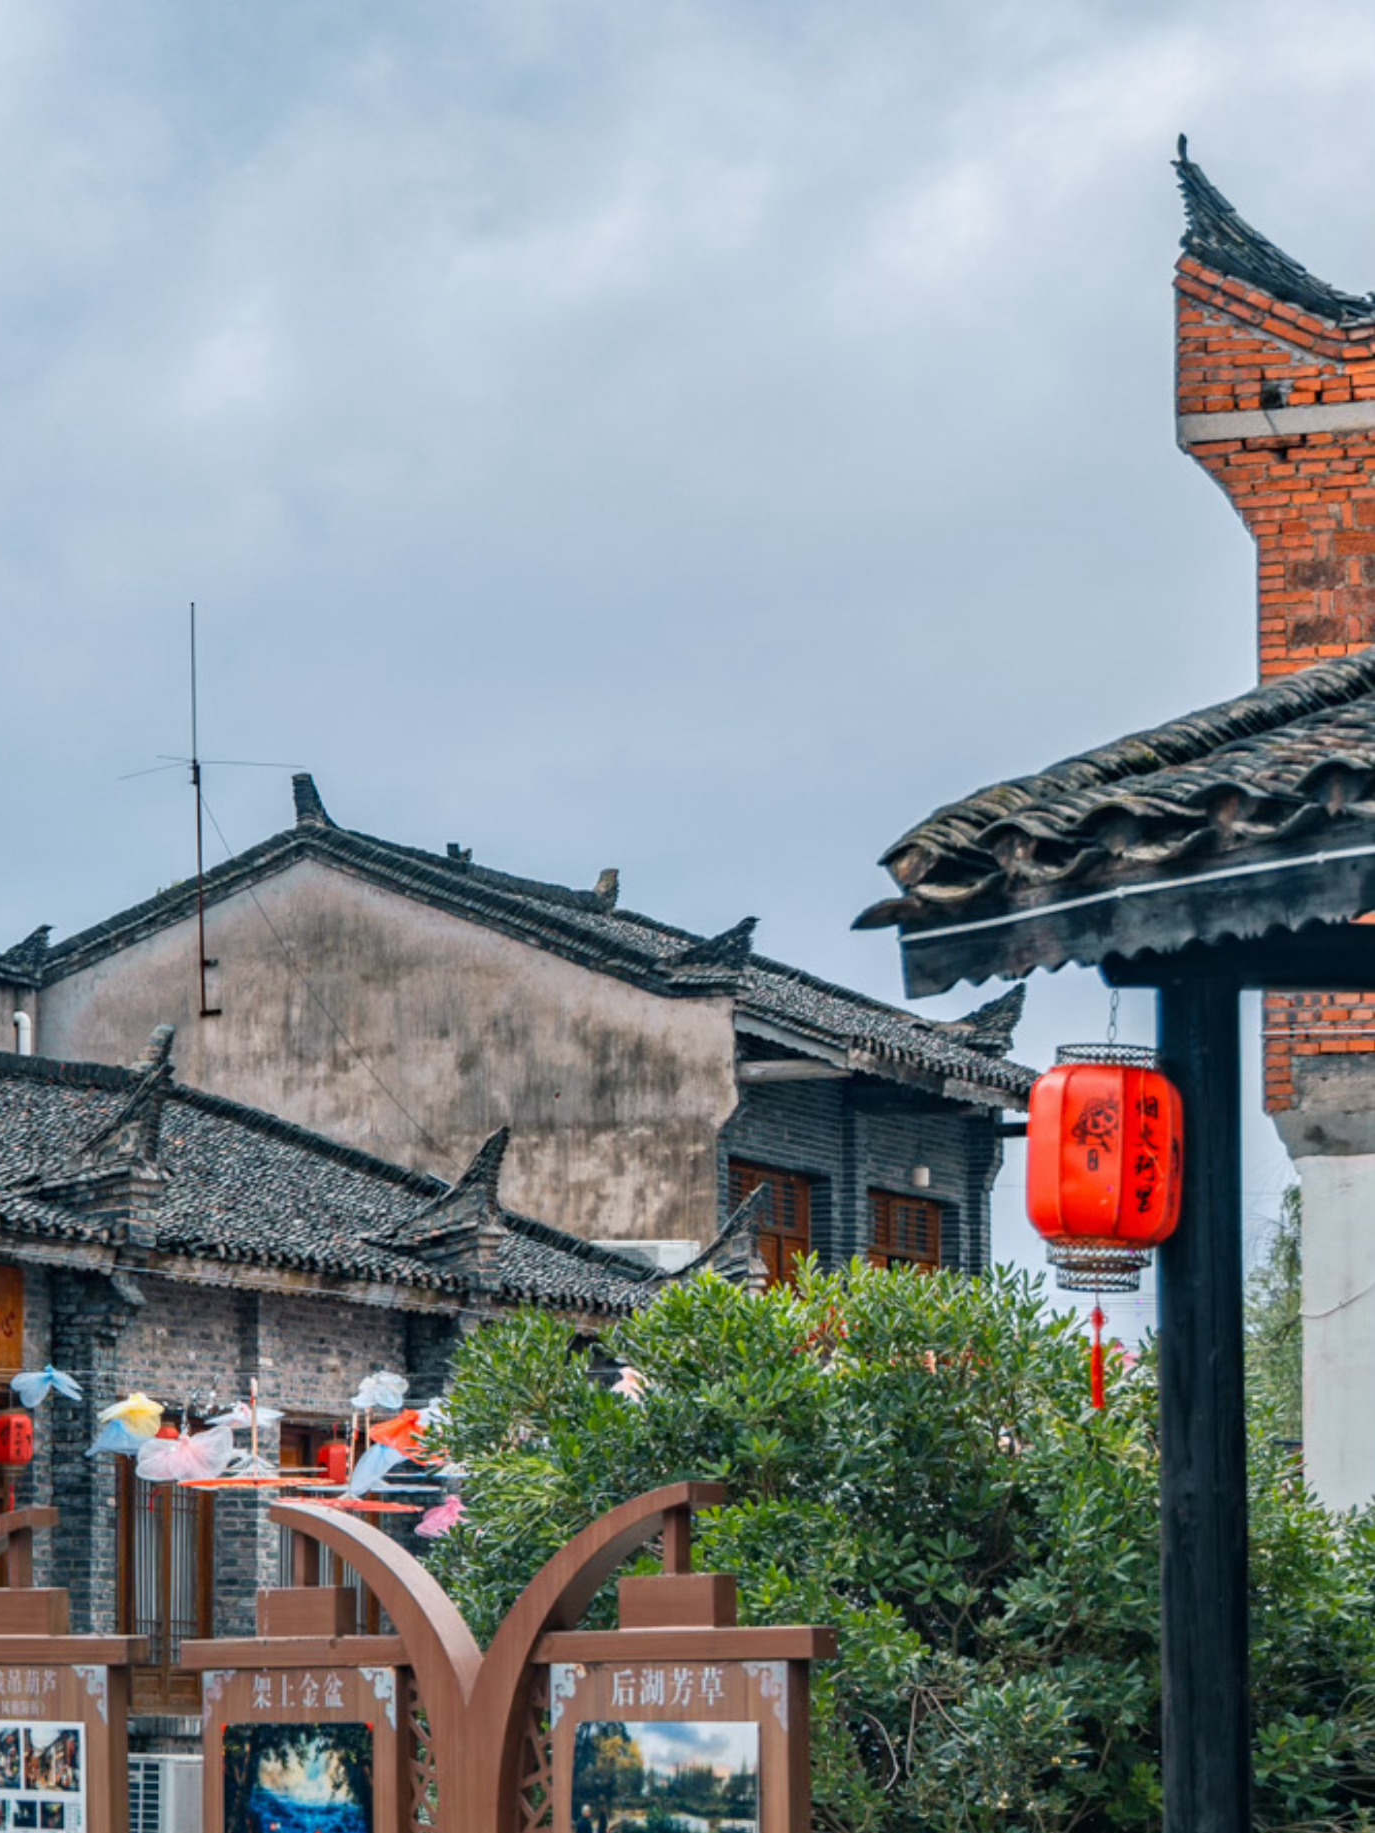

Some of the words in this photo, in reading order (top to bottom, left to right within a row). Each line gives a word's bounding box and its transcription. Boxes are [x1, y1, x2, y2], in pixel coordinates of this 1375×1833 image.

[253, 1672, 345, 1710] 架上金盆
[611, 1667, 725, 1708] 后湖芳草
